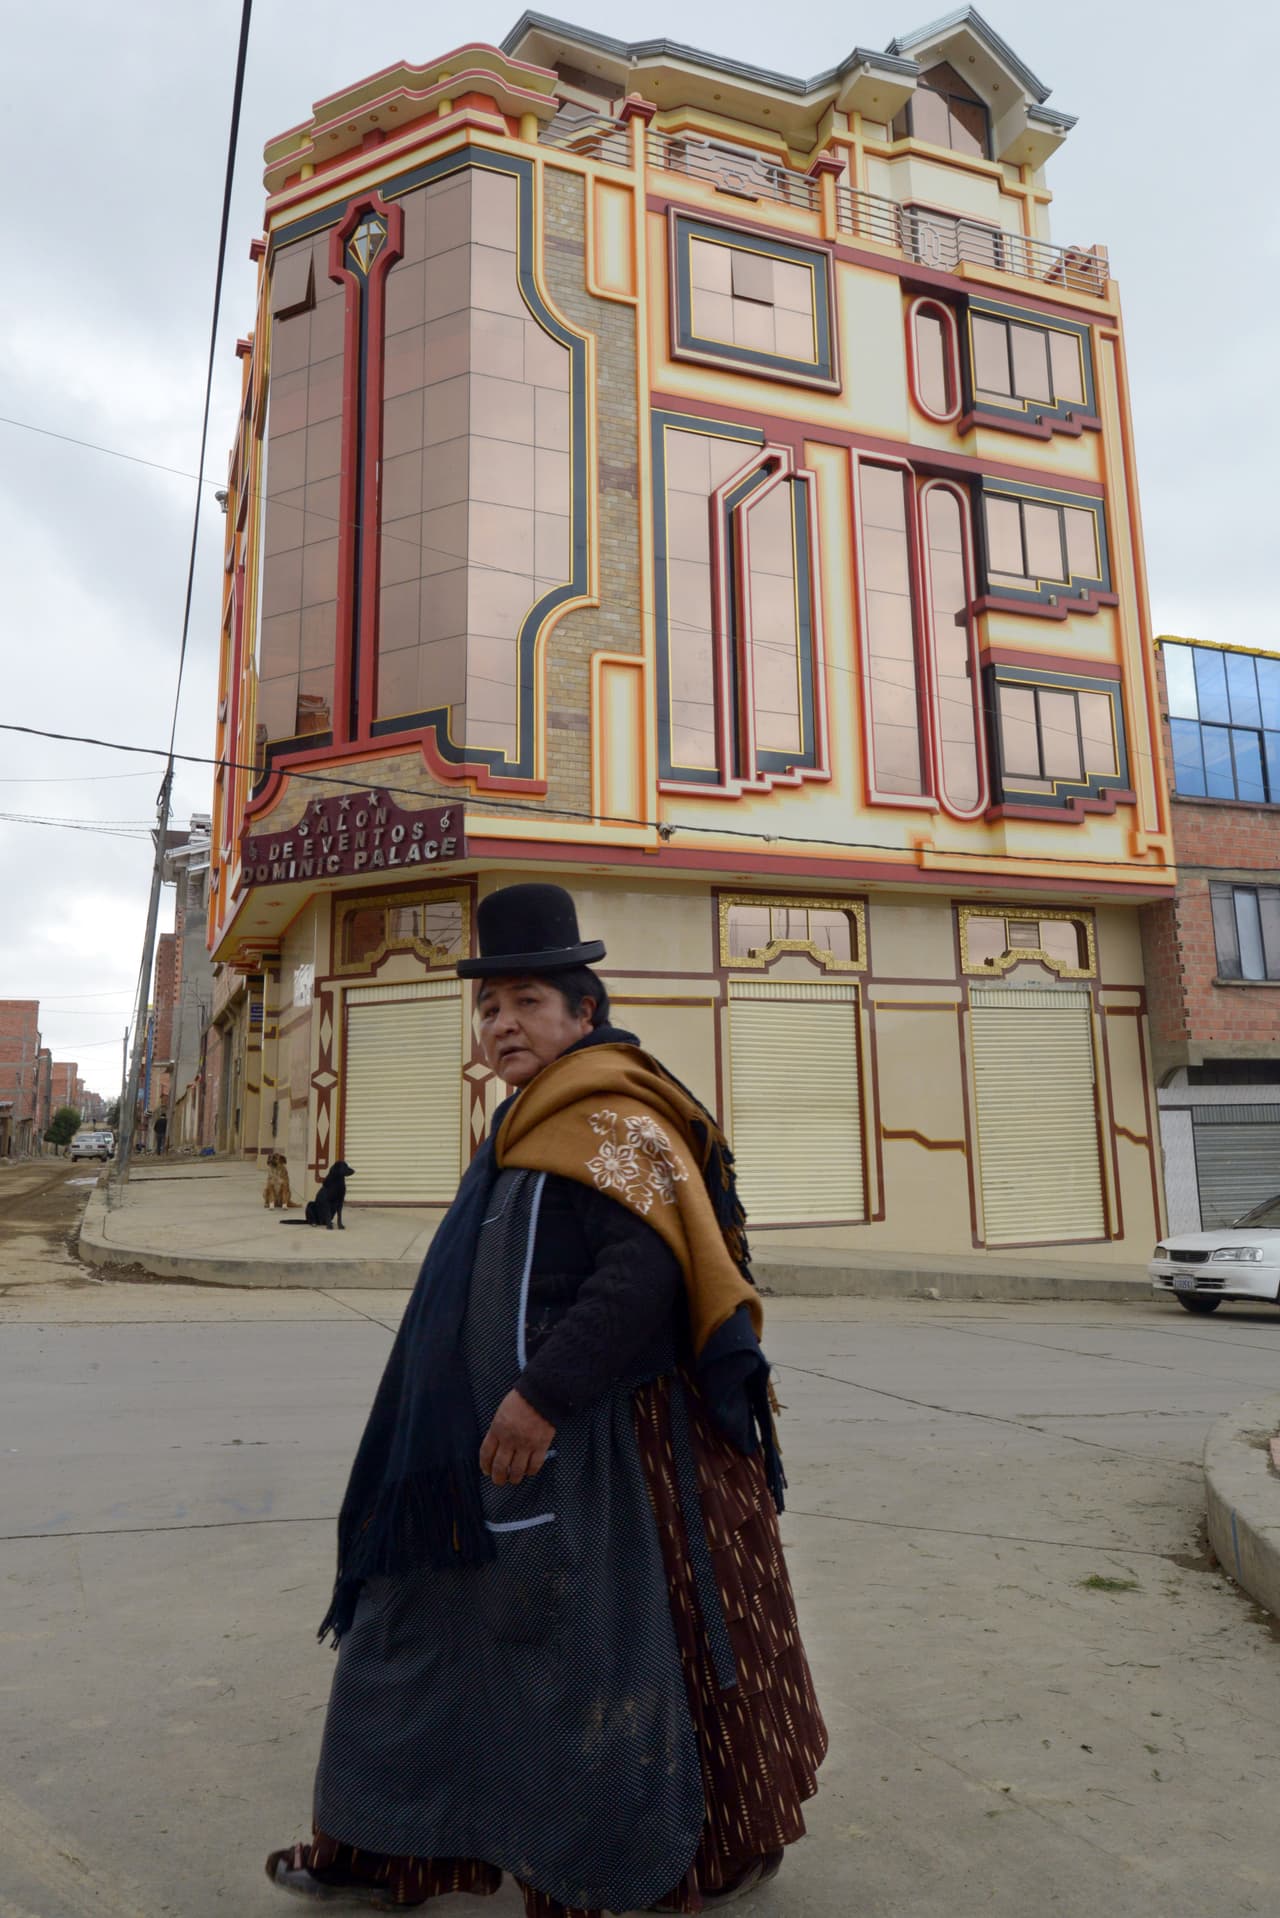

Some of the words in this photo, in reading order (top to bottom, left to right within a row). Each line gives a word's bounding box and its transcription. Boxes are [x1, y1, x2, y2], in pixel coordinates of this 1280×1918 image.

[269, 842, 295, 861] DE
[303, 822, 425, 856] EVENTOS
[298, 809, 388, 837] SALON
[241, 855, 341, 884] DOMINIC
[353, 837, 457, 870] PALACE
